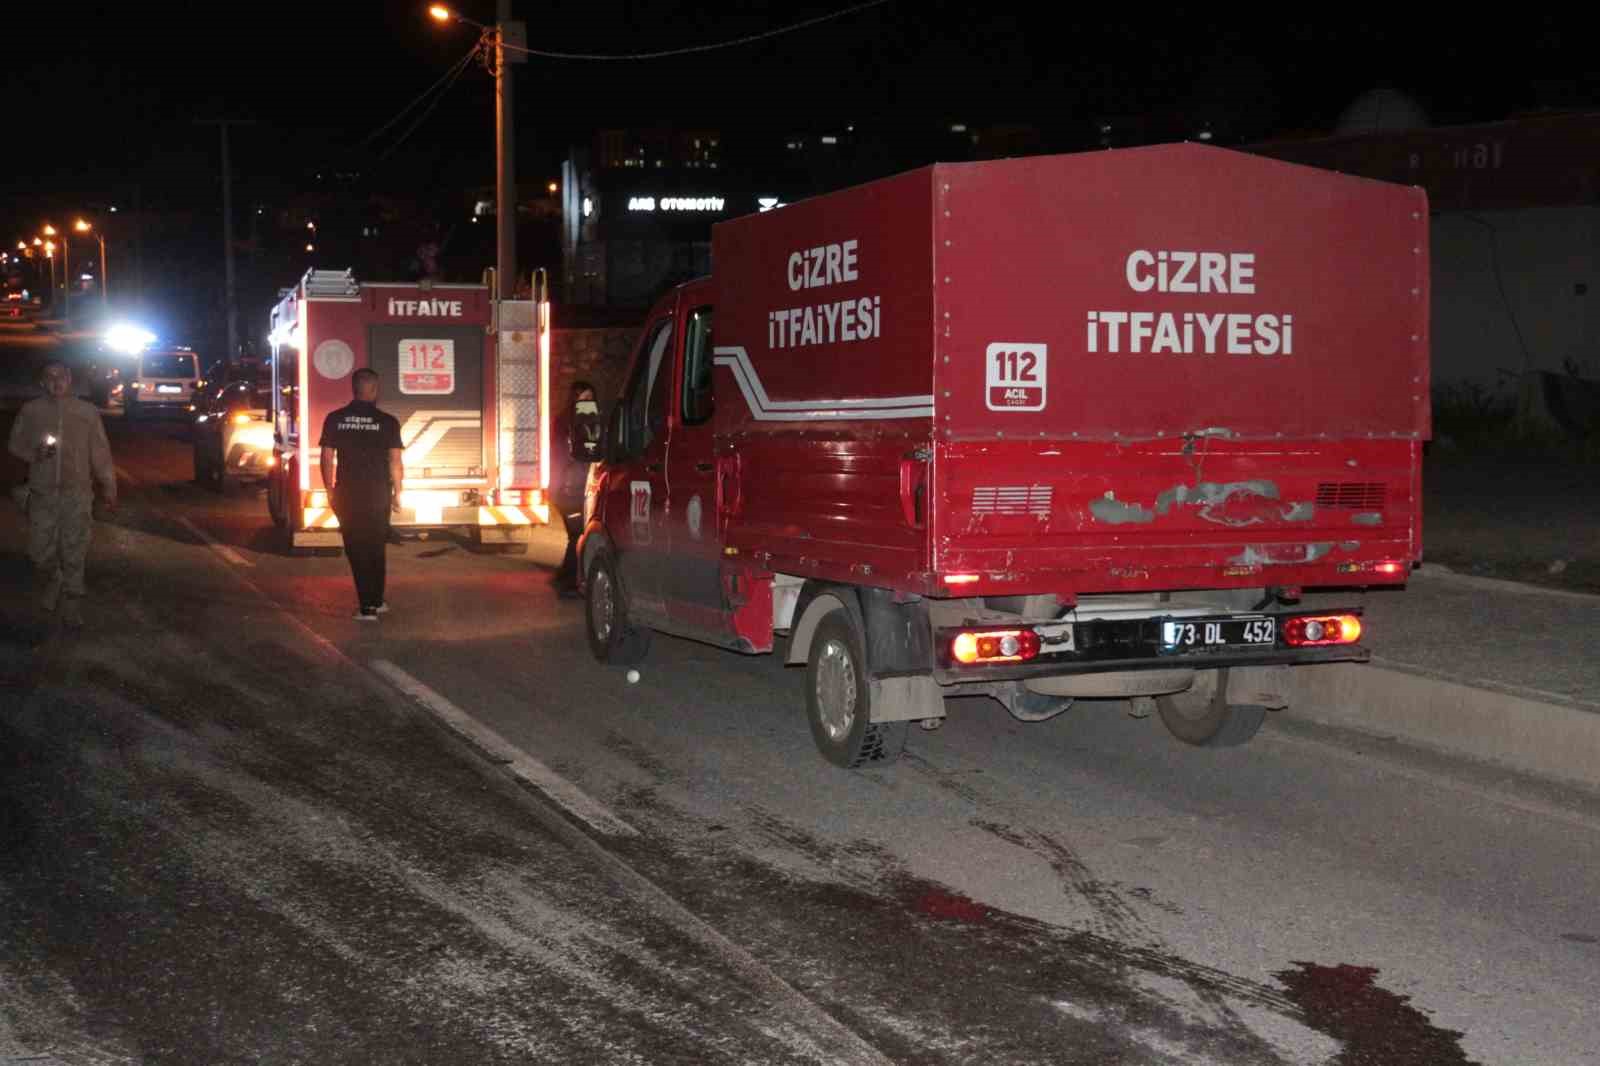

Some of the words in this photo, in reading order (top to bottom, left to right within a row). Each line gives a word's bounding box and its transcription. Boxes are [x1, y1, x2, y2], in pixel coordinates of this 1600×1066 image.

[388, 297, 463, 317] İTFAİYE
[409, 344, 446, 369] 112
[995, 351, 1037, 381] 112
[1175, 624, 1196, 645] 73
[1204, 623, 1226, 644] DL
[1243, 620, 1273, 643] 452
